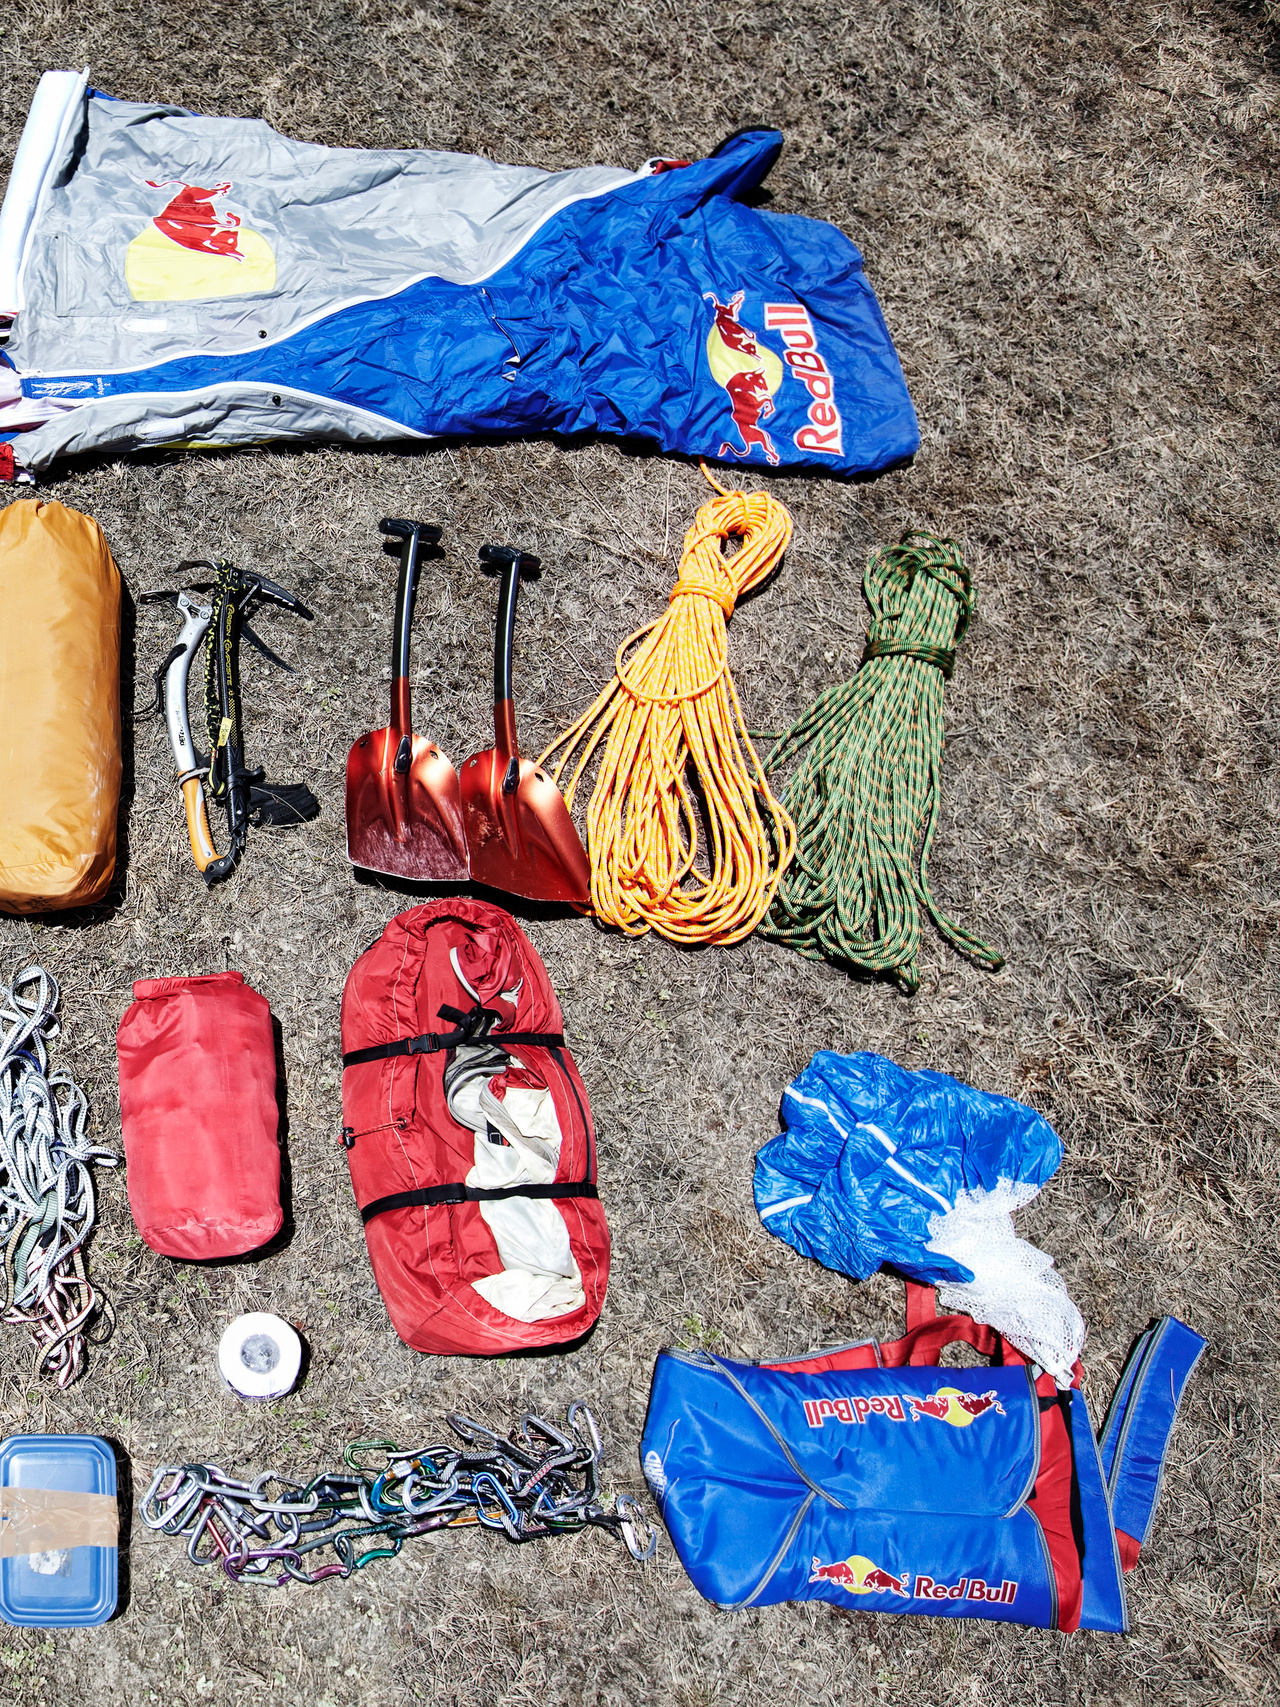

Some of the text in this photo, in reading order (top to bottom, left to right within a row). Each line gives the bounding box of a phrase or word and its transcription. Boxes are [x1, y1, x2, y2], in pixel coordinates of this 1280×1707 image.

[766, 305, 842, 455] Red Bull
[225, 603, 235, 637] CARBON
[804, 1396, 905, 1426] Red Bull
[914, 1576, 1017, 1604] Red Bull
